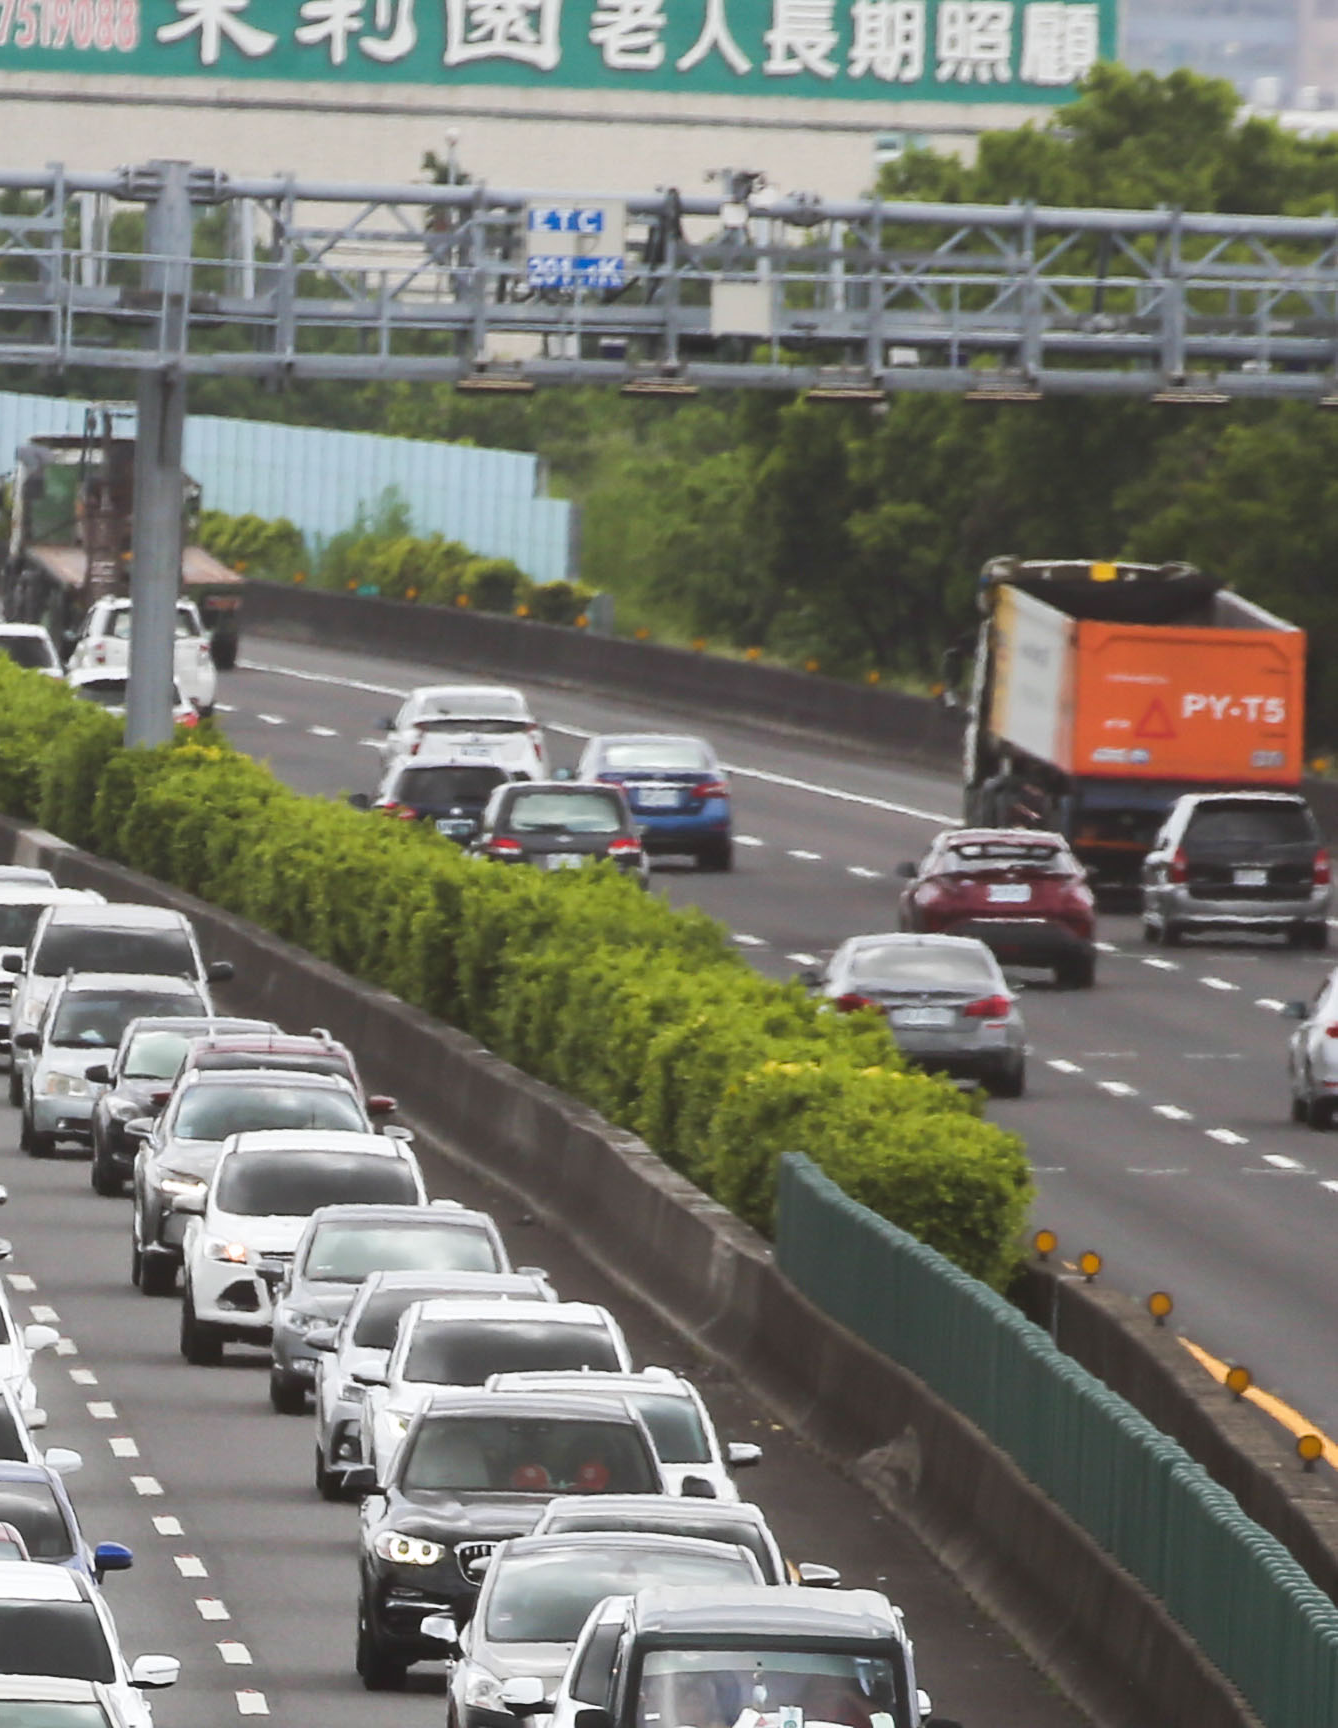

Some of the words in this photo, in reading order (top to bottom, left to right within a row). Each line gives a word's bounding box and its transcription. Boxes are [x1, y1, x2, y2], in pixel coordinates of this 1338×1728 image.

[587, 0, 1099, 85] 老人長期照顧
[532, 208, 600, 231] ETC
